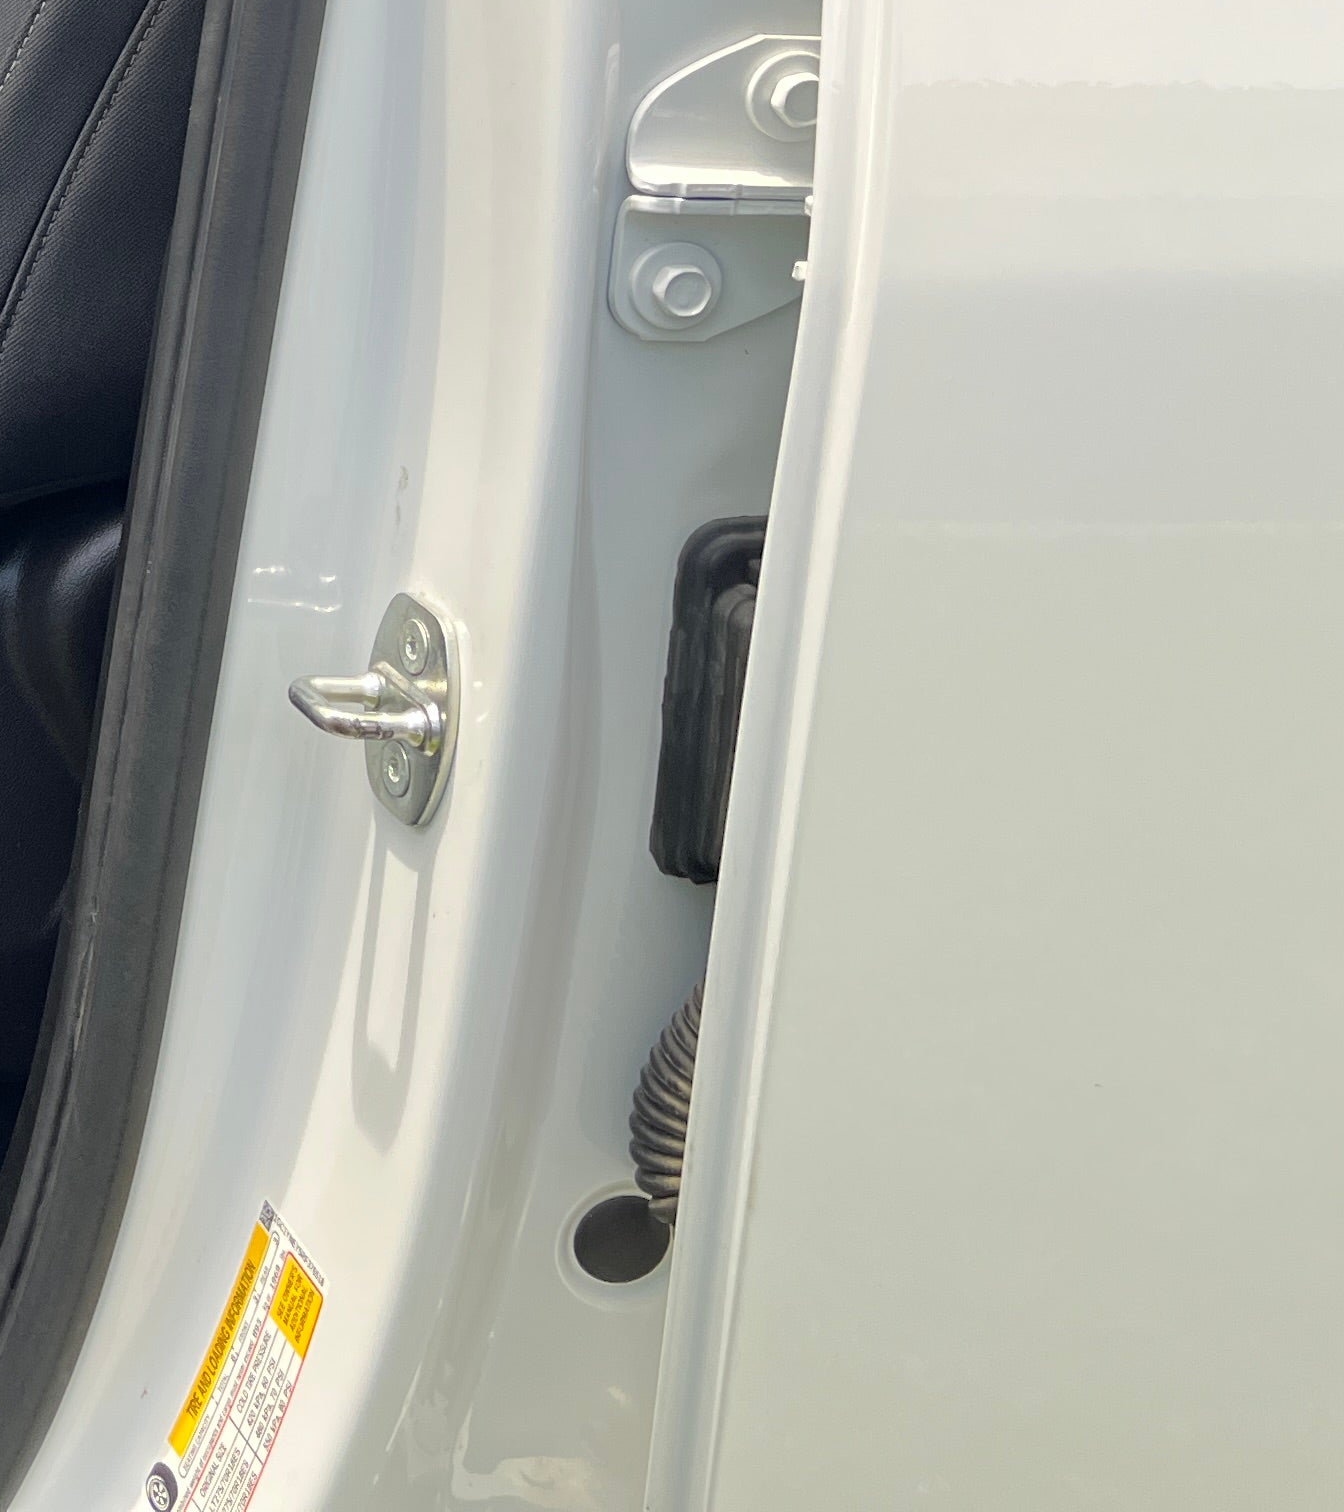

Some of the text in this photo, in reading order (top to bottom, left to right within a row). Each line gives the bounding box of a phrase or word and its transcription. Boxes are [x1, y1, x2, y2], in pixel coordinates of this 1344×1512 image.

[186, 1257, 256, 1422] TIRE AND LOADING INFORMATION
[236, 1388, 249, 1414] COLD
[251, 1329, 271, 1374] PRESSURE
